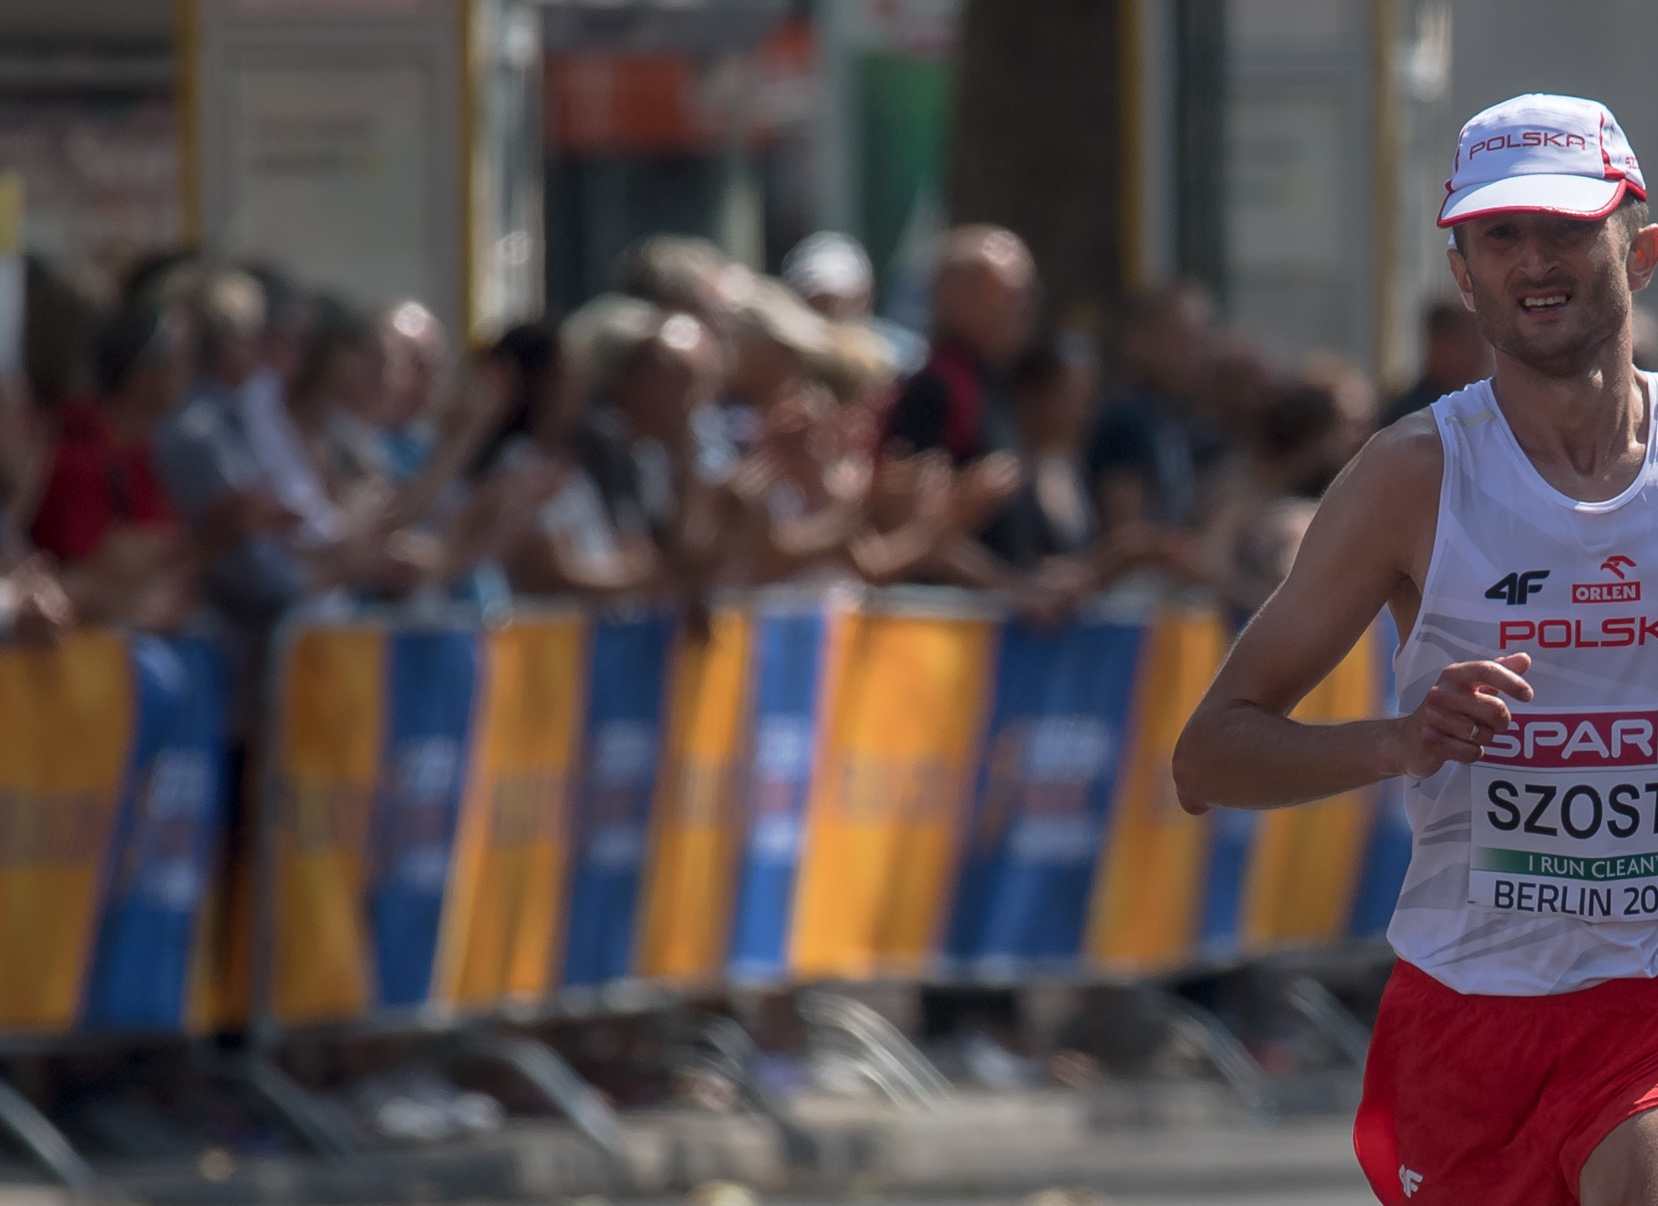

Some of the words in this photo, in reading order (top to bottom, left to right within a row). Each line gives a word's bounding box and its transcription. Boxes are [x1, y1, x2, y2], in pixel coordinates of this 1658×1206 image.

[1469, 131, 1586, 160] POLSKA
[1484, 569, 1551, 606] 4F
[1575, 584, 1637, 601] ORLEN
[1485, 718, 1653, 760] SPAR
[1528, 855, 1534, 872] I
[1541, 856, 1585, 877] RUN
[1494, 879, 1612, 917] BERLIN
